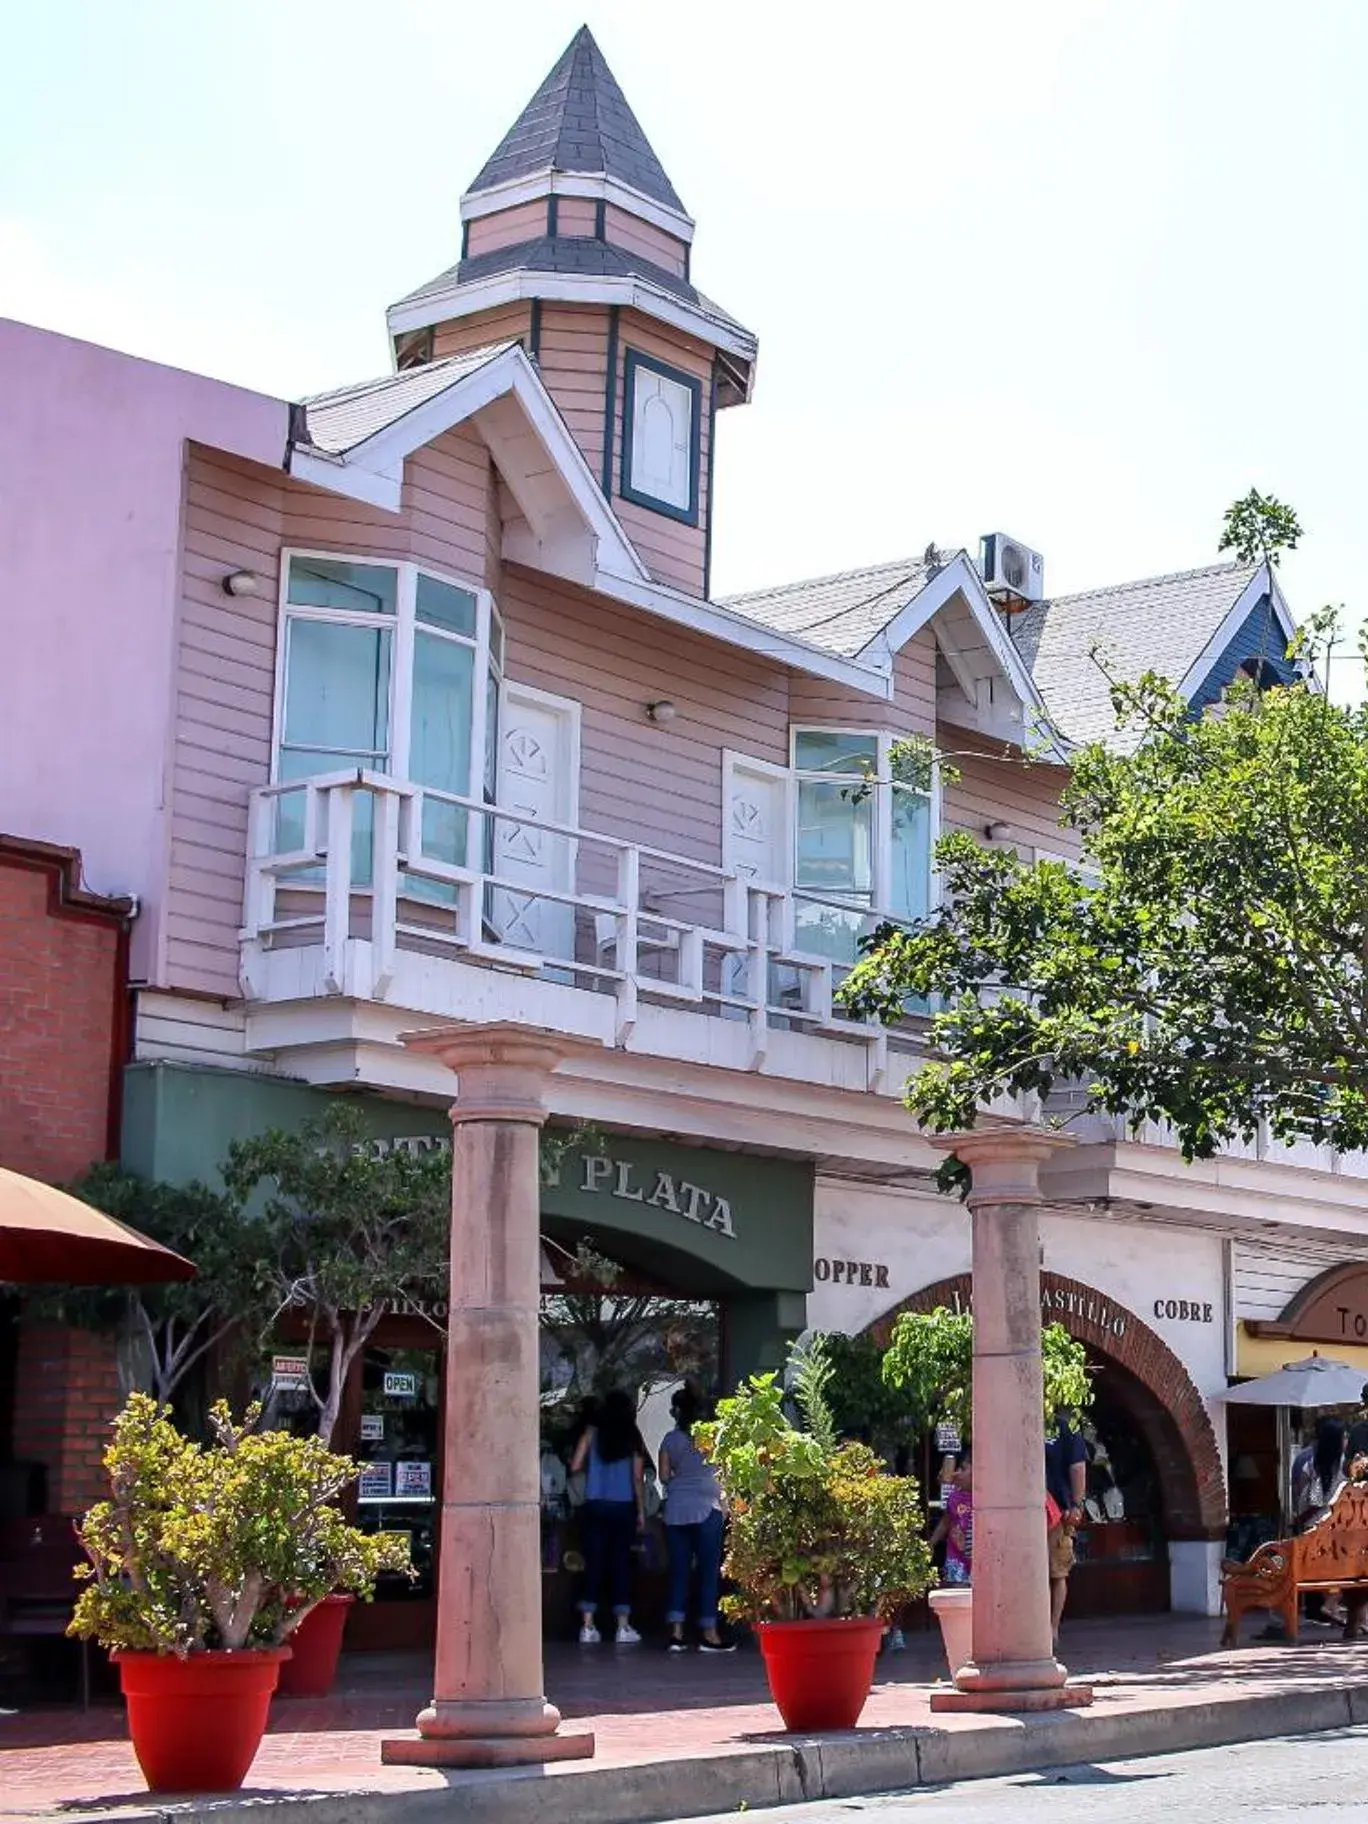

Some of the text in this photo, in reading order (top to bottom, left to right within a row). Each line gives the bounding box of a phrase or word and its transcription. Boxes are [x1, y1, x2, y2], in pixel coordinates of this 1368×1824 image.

[579, 1154, 737, 1240] PLATA
[814, 1258, 890, 1288] OPPER
[1039, 1288, 1126, 1338] ASTILLO
[1153, 1299, 1213, 1323] COBRE
[386, 1376, 412, 1392] OPEN
